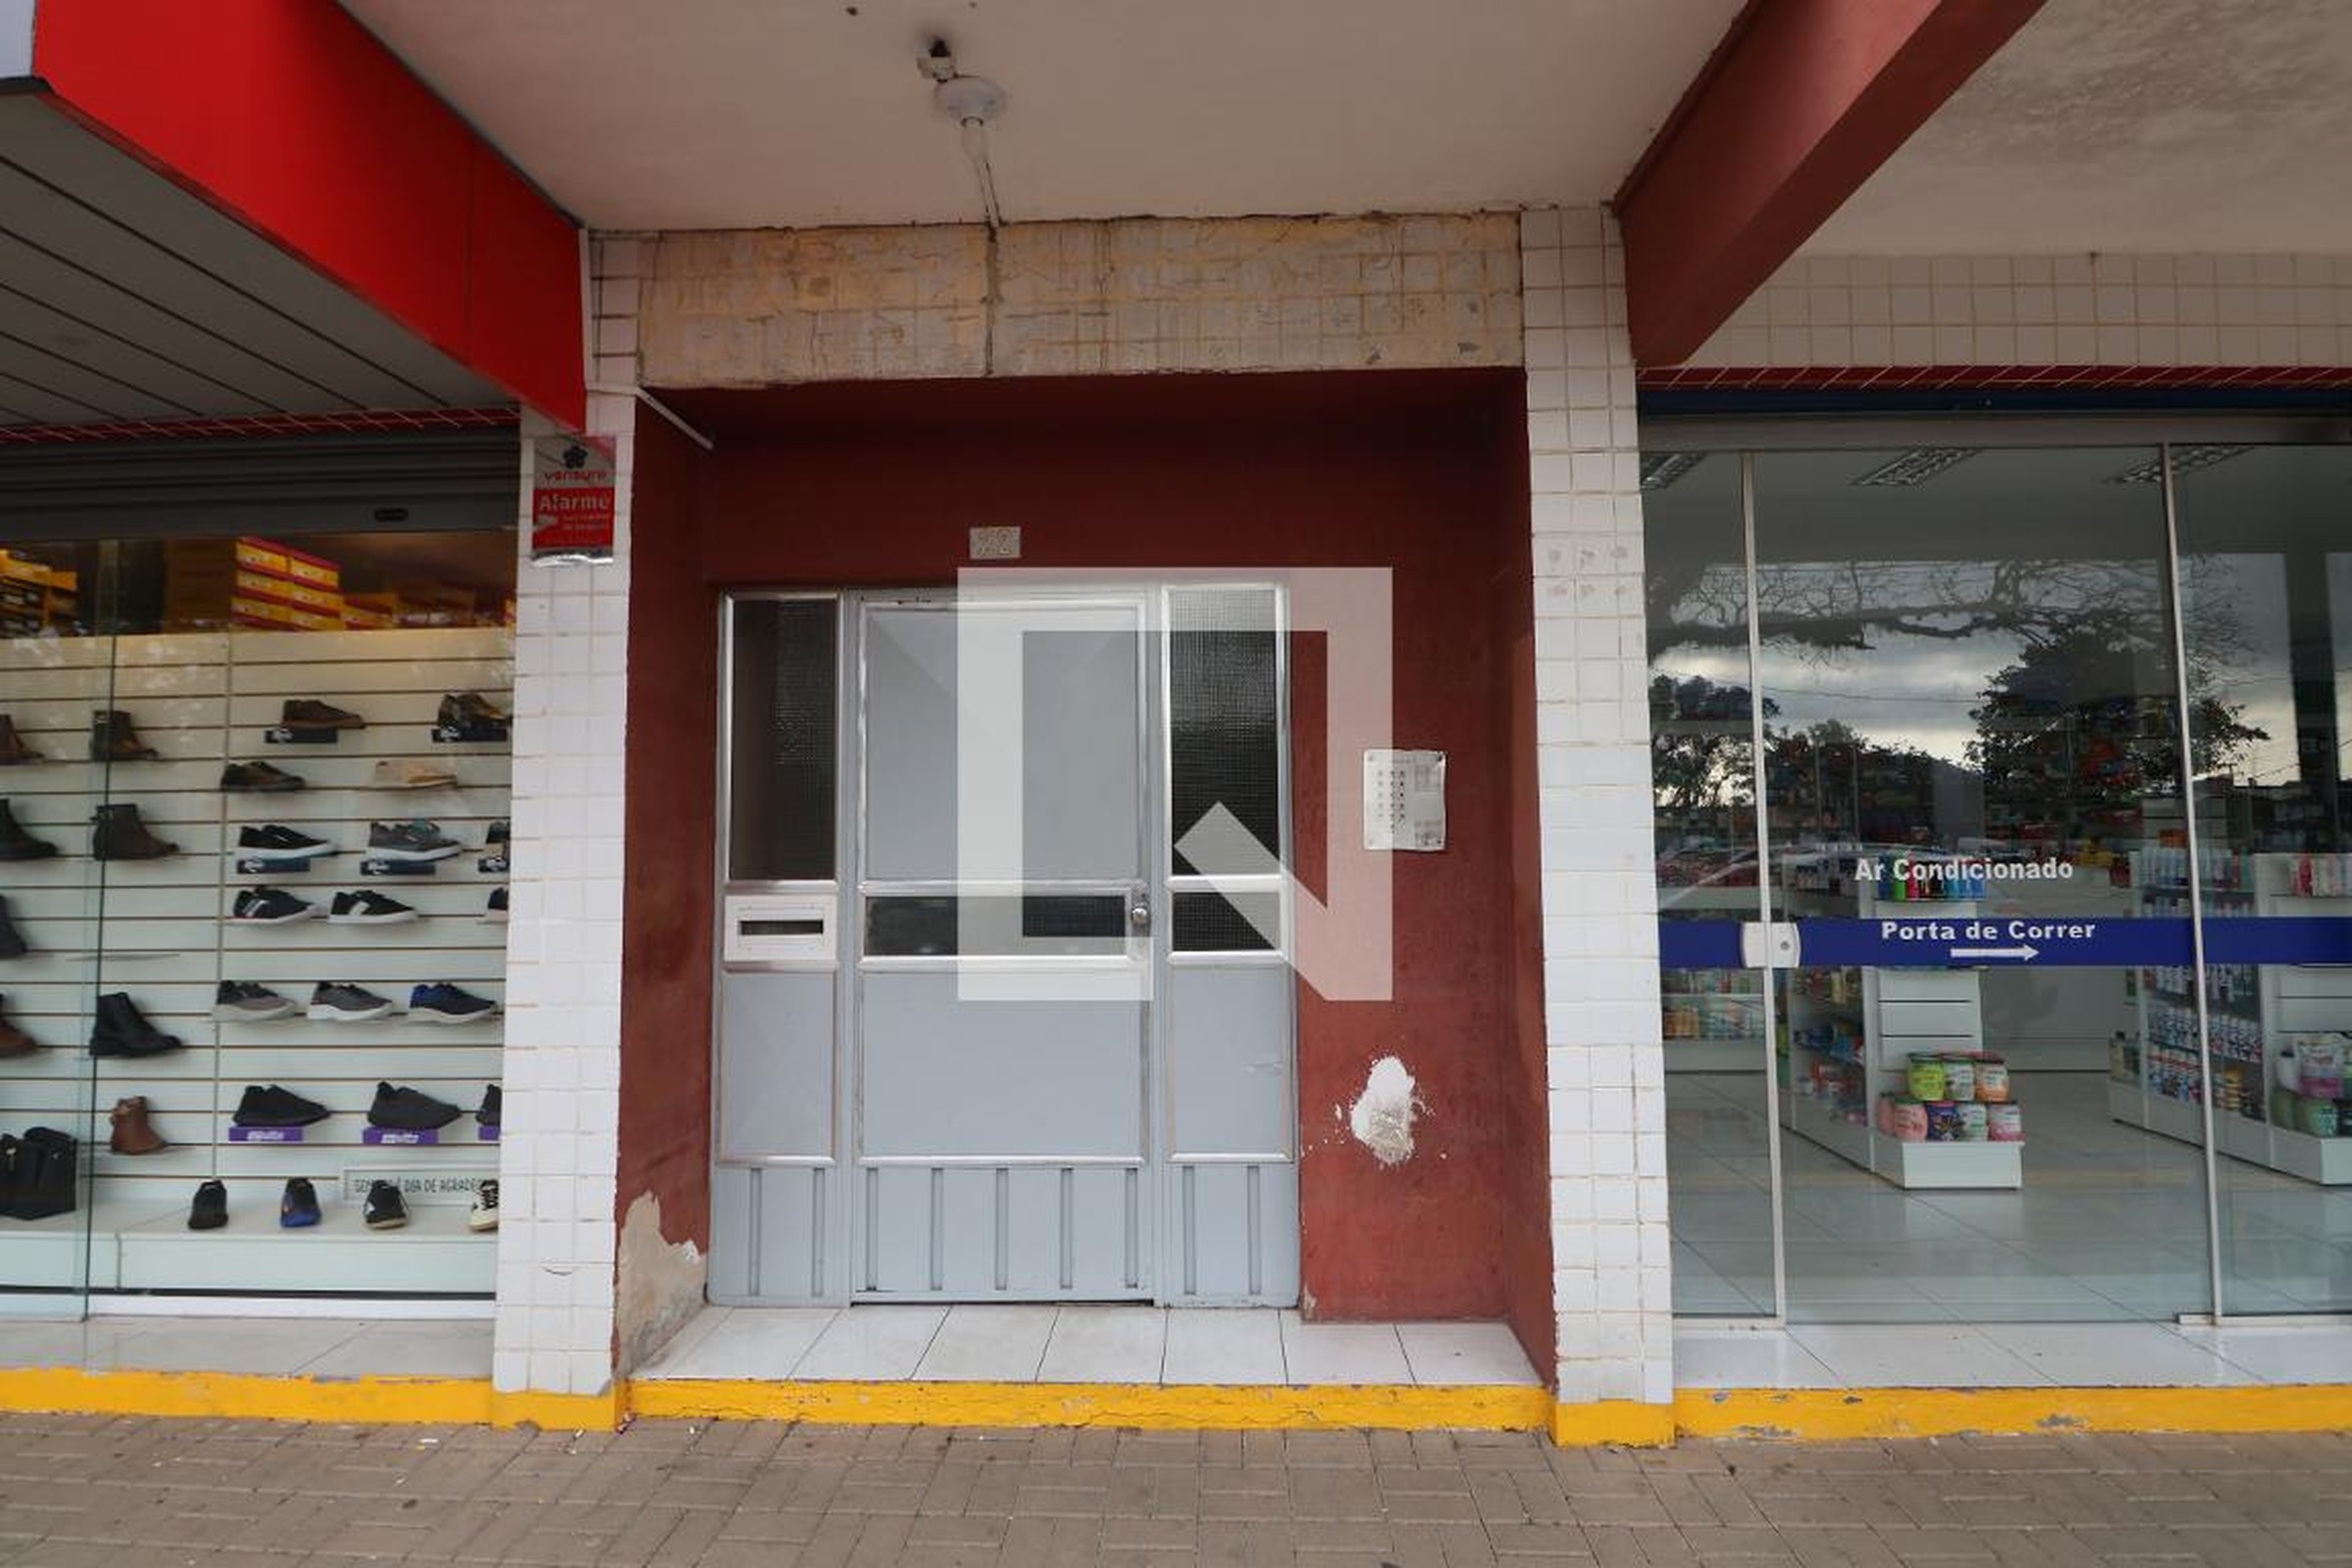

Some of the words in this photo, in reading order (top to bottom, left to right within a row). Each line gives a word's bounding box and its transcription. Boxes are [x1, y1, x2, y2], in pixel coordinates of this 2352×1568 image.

[539, 494, 608, 511] Alarme
[1855, 858, 1885, 881] Ar
[1893, 856, 2073, 881] Condicionado
[1881, 921, 1956, 940] Porta
[1966, 921, 1998, 940] de
[2008, 921, 2095, 939] Correr
